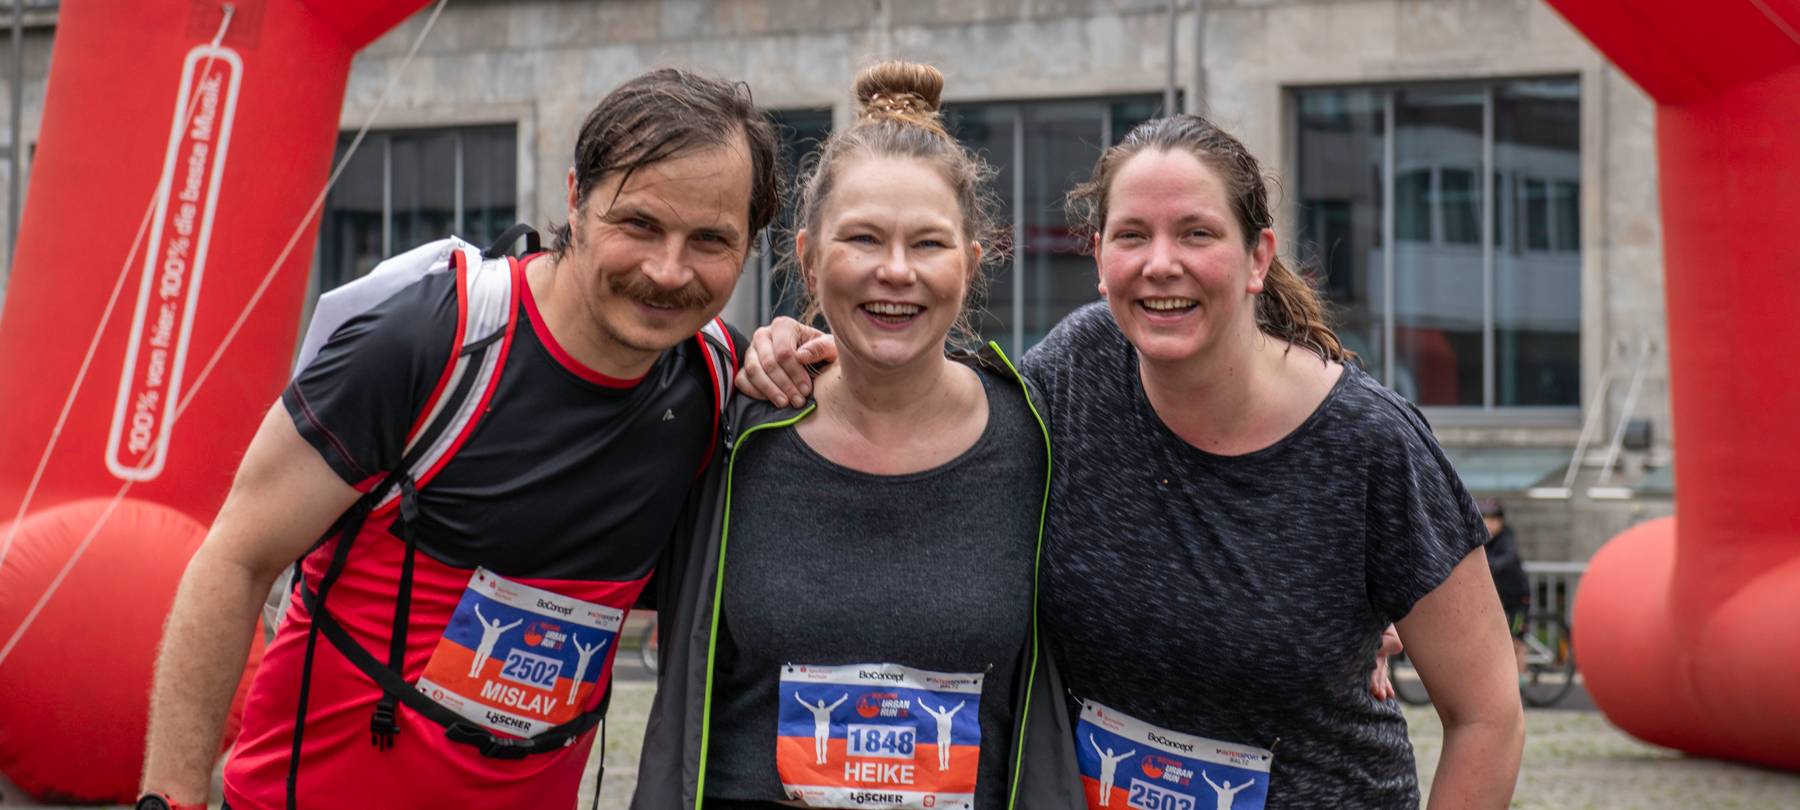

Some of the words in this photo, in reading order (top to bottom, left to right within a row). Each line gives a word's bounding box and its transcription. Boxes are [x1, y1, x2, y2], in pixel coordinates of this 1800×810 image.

[179, 142, 208, 202] beste
[174, 202, 197, 236] die
[160, 237, 190, 299] 100%
[146, 349, 167, 387] von
[128, 390, 159, 454] 100%
[536, 598, 573, 617] BoConcept
[502, 653, 560, 686] 2502
[859, 671, 904, 684] BoConcept
[480, 679, 558, 716] MISLAV
[881, 699, 911, 710] URBAN
[486, 711, 532, 731] LÖSCHER
[850, 728, 913, 755] 1848
[1148, 732, 1194, 753] BoConcept
[844, 762, 914, 785] HEIKE
[1165, 764, 1194, 779] URBAN
[850, 792, 904, 804] LÖSCHER
